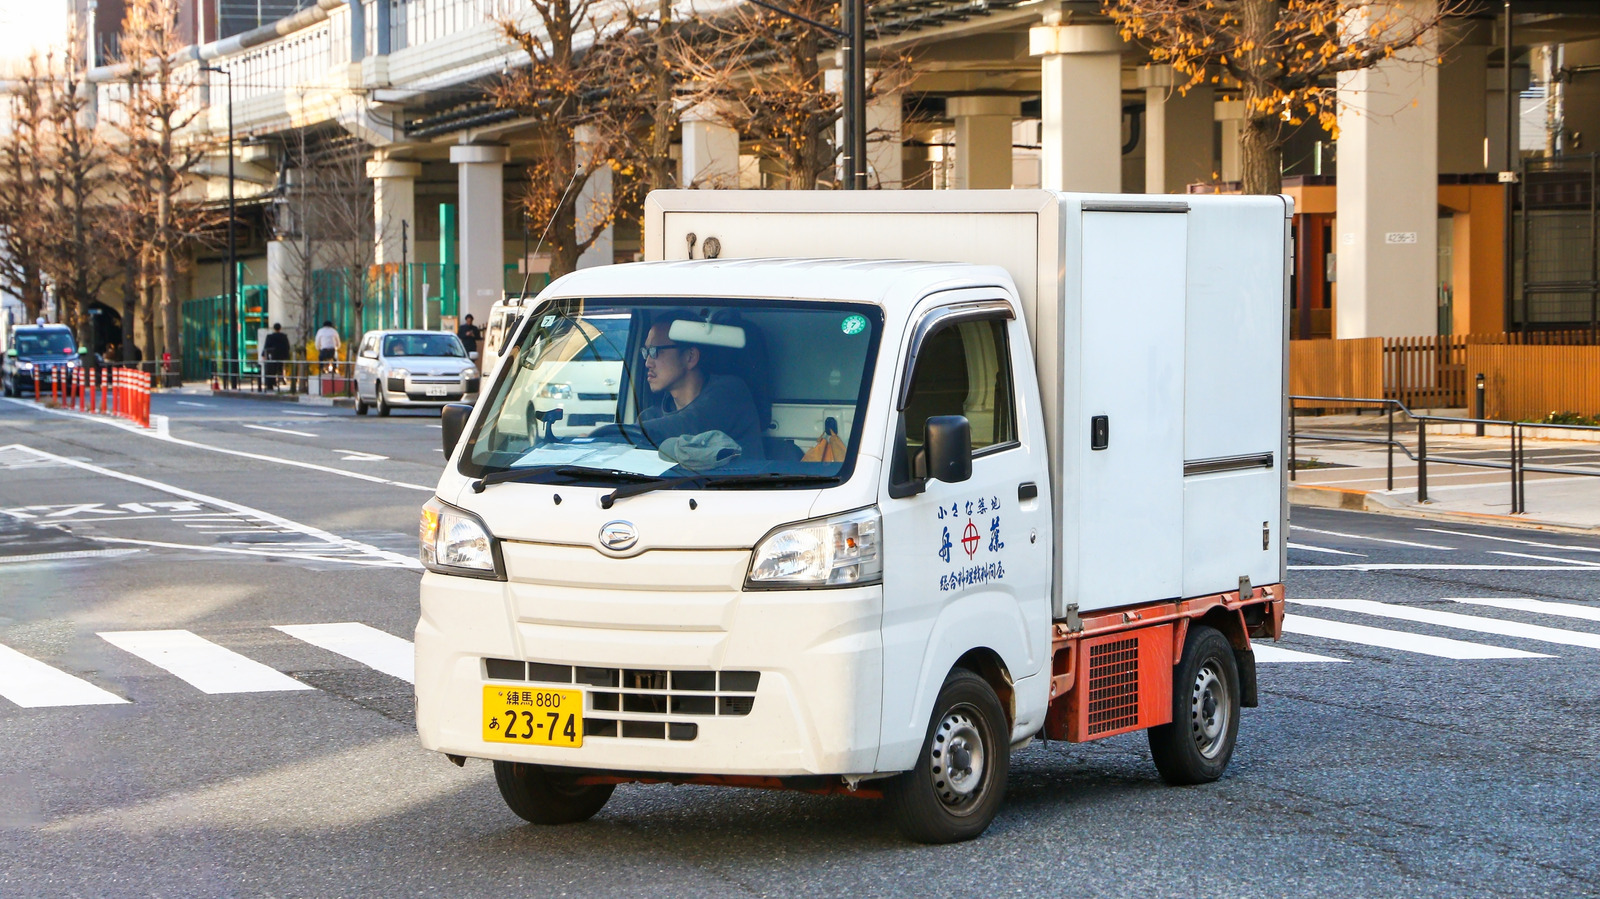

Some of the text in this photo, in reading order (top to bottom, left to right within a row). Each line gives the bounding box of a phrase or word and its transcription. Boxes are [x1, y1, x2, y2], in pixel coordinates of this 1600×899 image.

[938, 496, 1000, 519] 小さな築地
[506, 691, 561, 708] 練馬 880
[488, 709, 576, 743] あ 23-74
